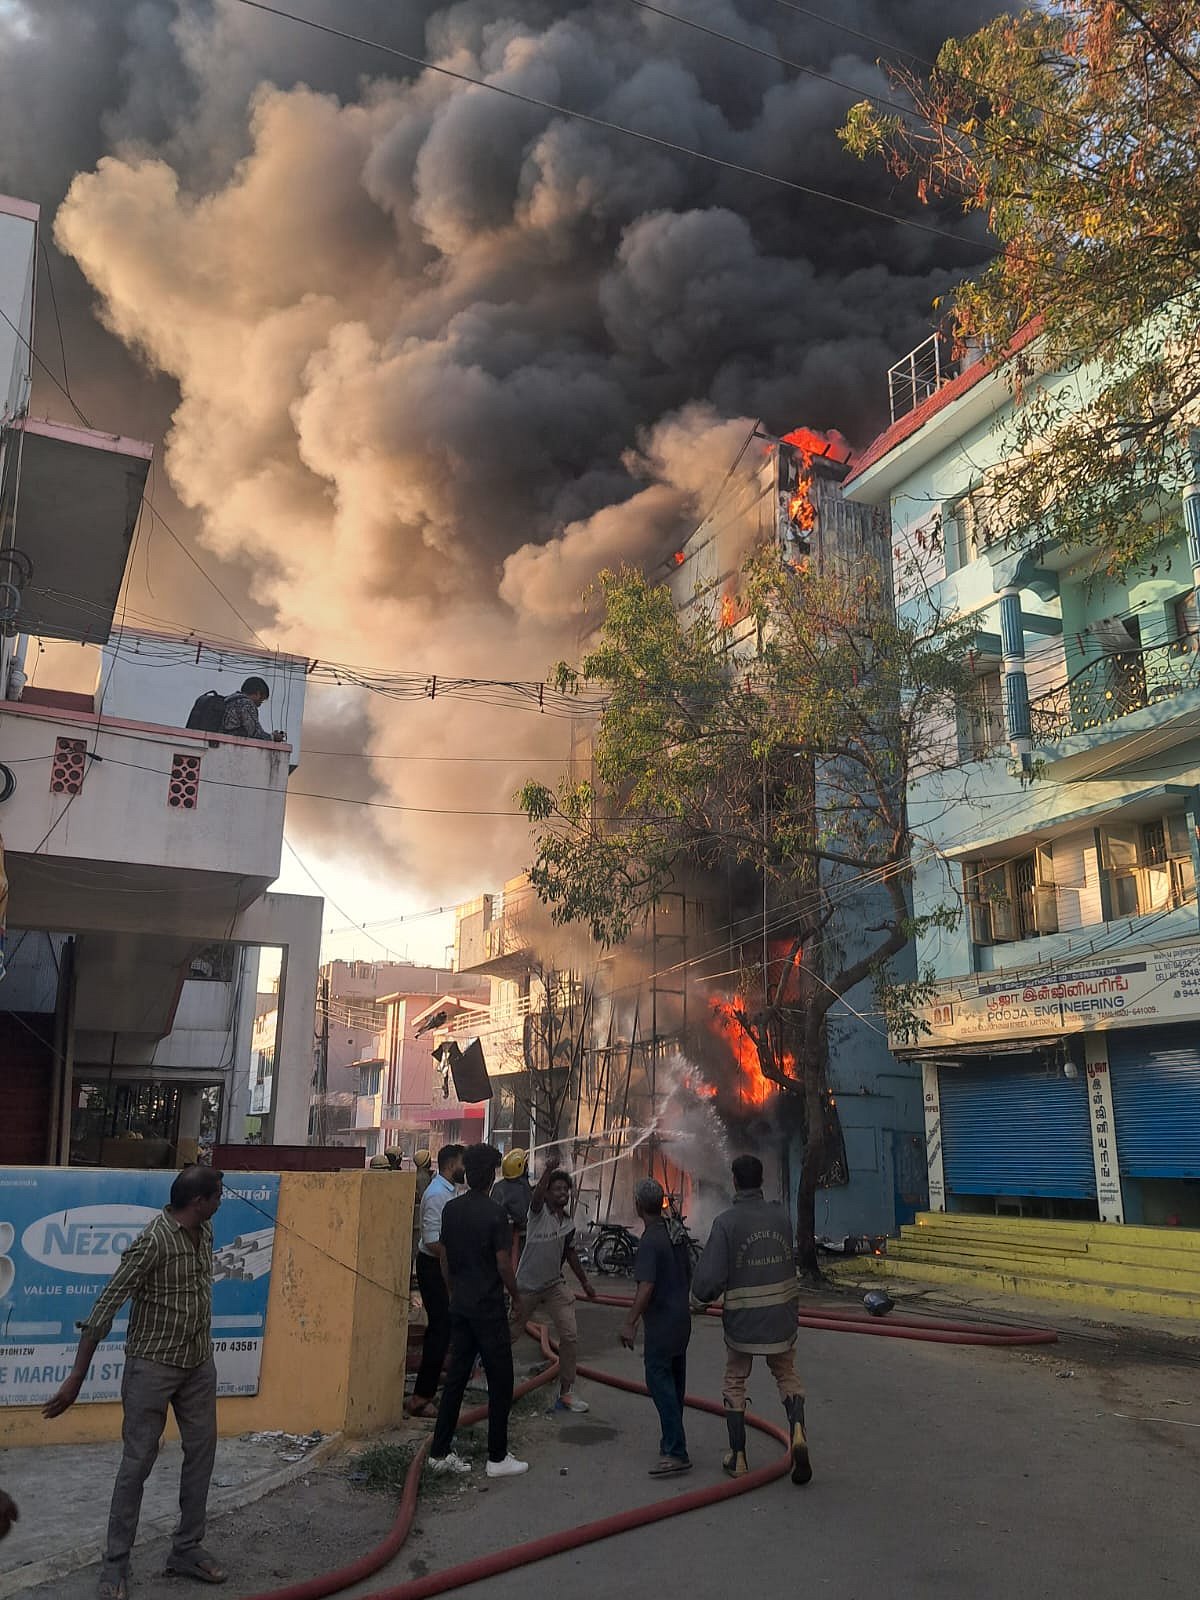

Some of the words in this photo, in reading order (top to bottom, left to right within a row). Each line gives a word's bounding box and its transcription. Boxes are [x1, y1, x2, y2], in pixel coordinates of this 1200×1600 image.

[988, 1009, 1029, 1022] POOJA
[1034, 996, 1125, 1016] ENGINEERING
[24, 1285, 63, 1295] VALUE
[66, 1284, 99, 1294] BUILT
[230, 1341, 257, 1352] 43581
